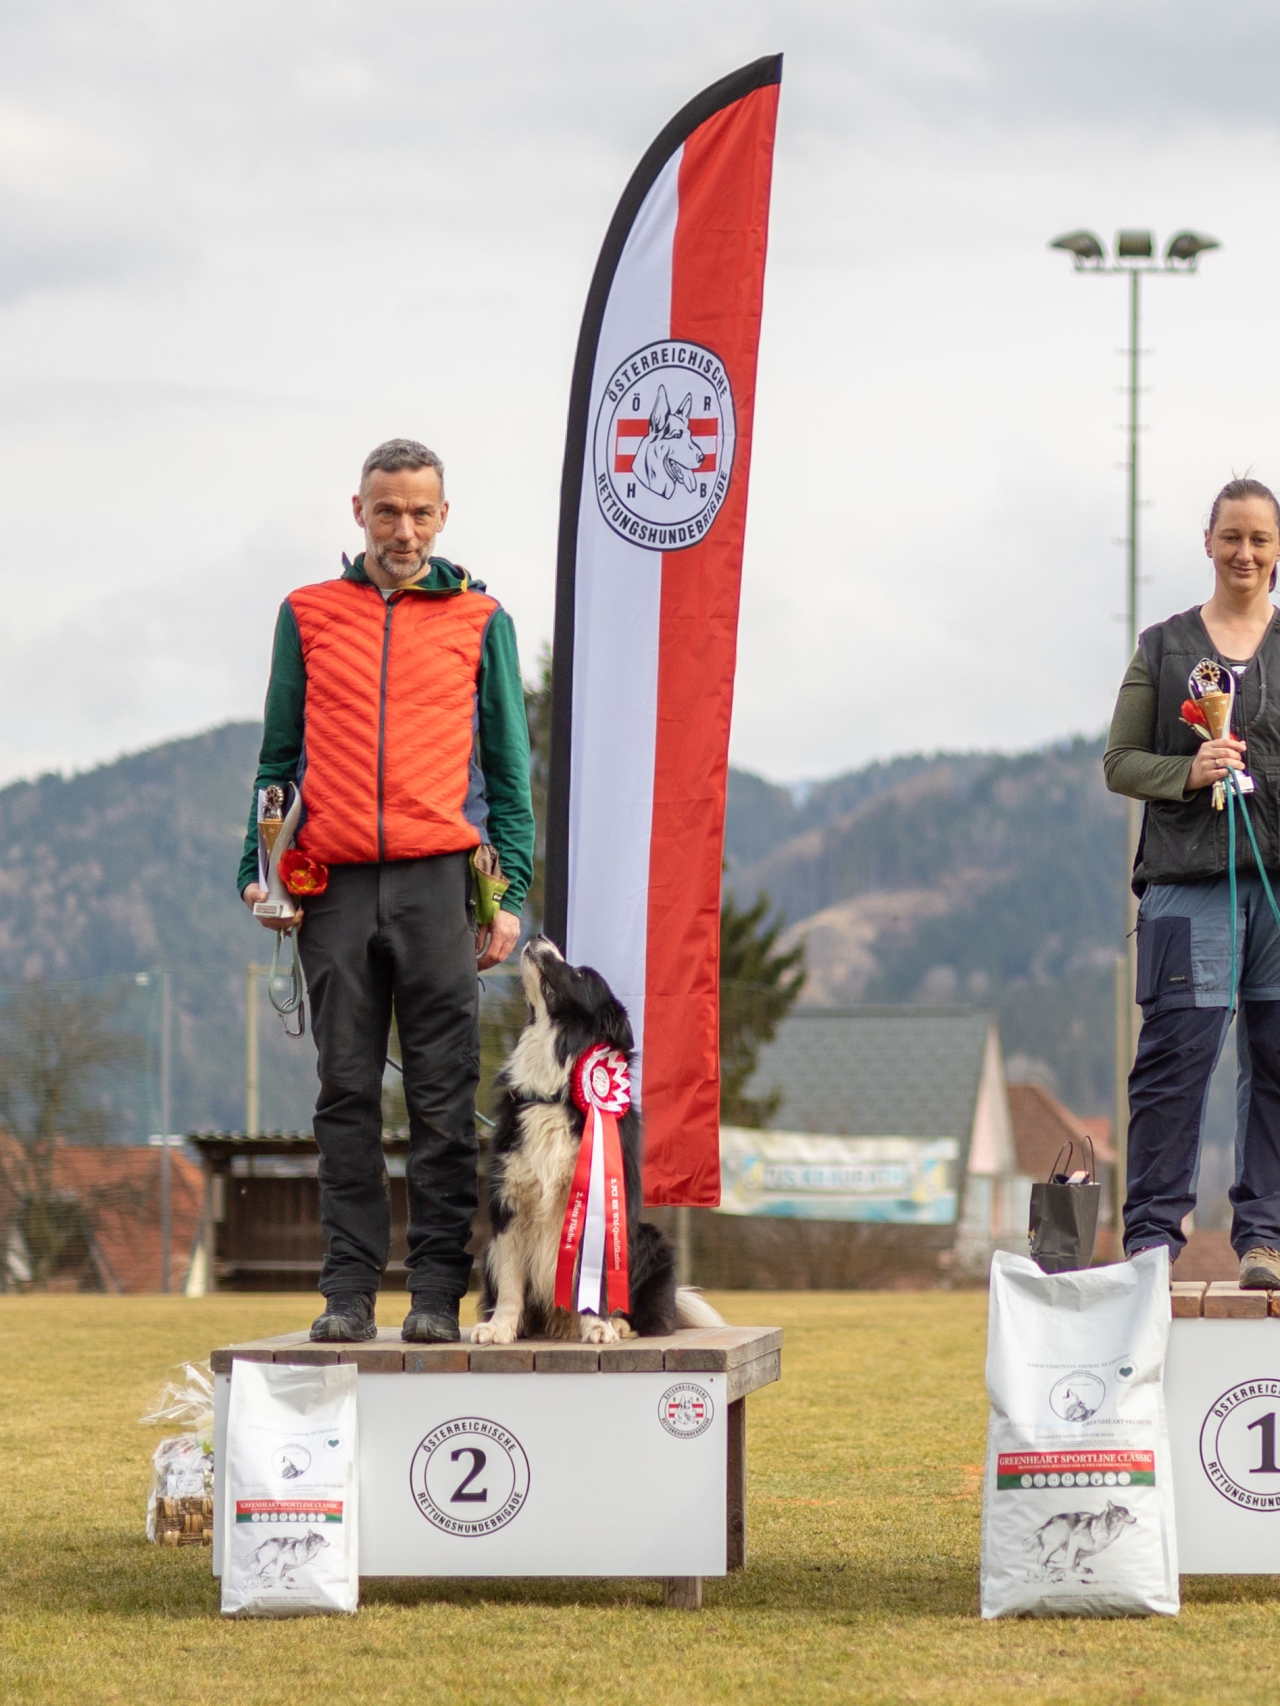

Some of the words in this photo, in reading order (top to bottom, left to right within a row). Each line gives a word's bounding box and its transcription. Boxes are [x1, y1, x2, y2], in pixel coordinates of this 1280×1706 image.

[606, 347, 728, 403] ÖSTERREICHISCHE
[704, 396, 711, 411] R
[627, 483, 636, 498] H
[700, 483, 707, 498] B
[598, 471, 728, 544] RETTUNGSHUNDEBRIGADE
[572, 1200, 582, 1217] Platz
[612, 1199, 619, 1210] RH
[566, 1218, 578, 1243] Fläche
[611, 1212, 621, 1270] WM-Qualifikation
[422, 1421, 516, 1453] ÖSTERREICHISCHE
[999, 1455, 1059, 1466] GREENHEART
[1060, 1454, 1116, 1464] SPORTLINE
[1118, 1453, 1153, 1463] CLASSIC
[450, 1447, 488, 1503] 2
[417, 1491, 523, 1533] RETTUNGSHUNDEBRIGADE
